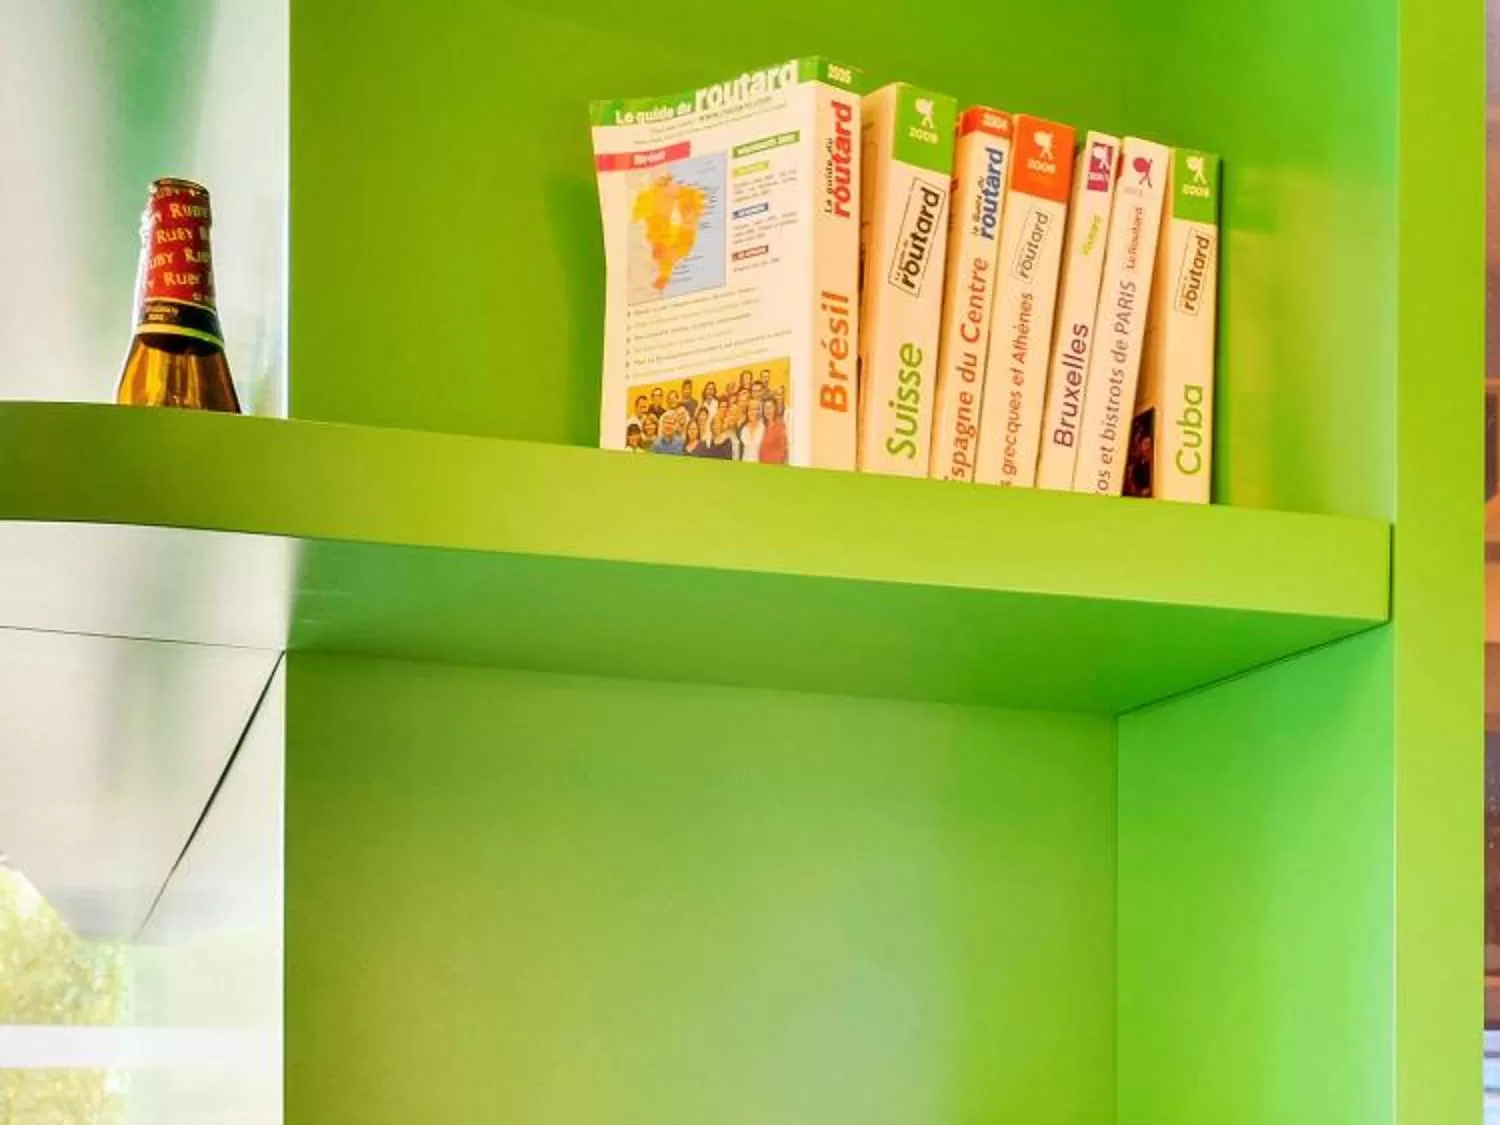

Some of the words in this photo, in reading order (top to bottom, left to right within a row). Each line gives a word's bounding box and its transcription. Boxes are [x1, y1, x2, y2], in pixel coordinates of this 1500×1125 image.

[695, 59, 798, 113] routard
[832, 100, 852, 219] routard
[981, 147, 1005, 240] routard
[902, 187, 941, 290] routard
[1021, 212, 1049, 279] routard
[1184, 235, 1210, 311] routard
[960, 257, 988, 343] Centre
[1116, 281, 1137, 330] PARIS
[820, 291, 851, 413] Brésil
[954, 350, 977, 384] du
[1054, 323, 1088, 448] Bruxelles
[1114, 331, 1129, 363] de
[886, 342, 923, 460] Suisse
[946, 391, 977, 482] spagne
[1000, 394, 1022, 479] grecques
[1014, 363, 1024, 386] et
[1103, 367, 1127, 441] bistrots
[1176, 384, 1203, 475] Cuba
[1103, 441, 1113, 465] et
